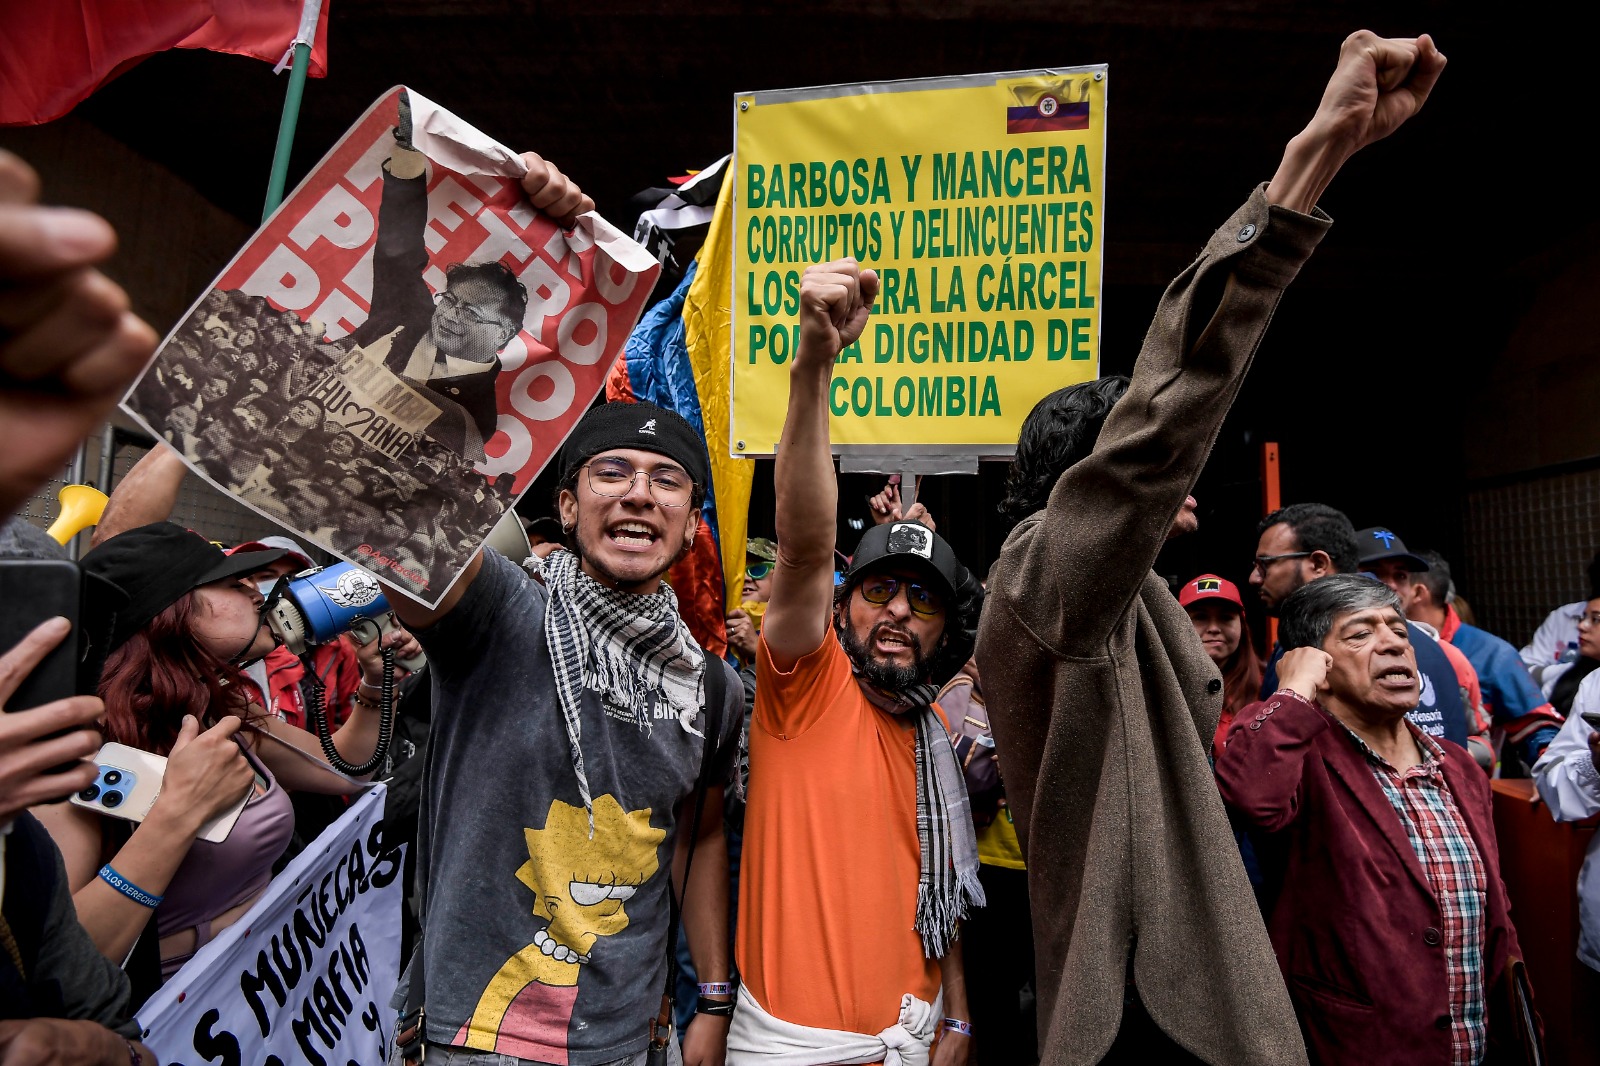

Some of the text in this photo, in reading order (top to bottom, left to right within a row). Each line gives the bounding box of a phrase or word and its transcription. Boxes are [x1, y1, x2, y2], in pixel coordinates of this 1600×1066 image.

[747, 144, 1092, 208] BARBOSA Y MANCERA
[747, 200, 1094, 264] CORRUPTOS Y DELINCUENTES
[748, 270, 800, 316] LOS
[931, 265, 966, 313] LA
[976, 256, 1095, 312] CÁRCEL
[875, 320, 1035, 364] DIGNIDAD
[1047, 318, 1091, 360] DE
[829, 375, 1001, 417] COLOMBIA
[107, 872, 123, 887] LOS
[240, 820, 402, 1039] MUÑECAS
[292, 922, 370, 1066] MAFIA
